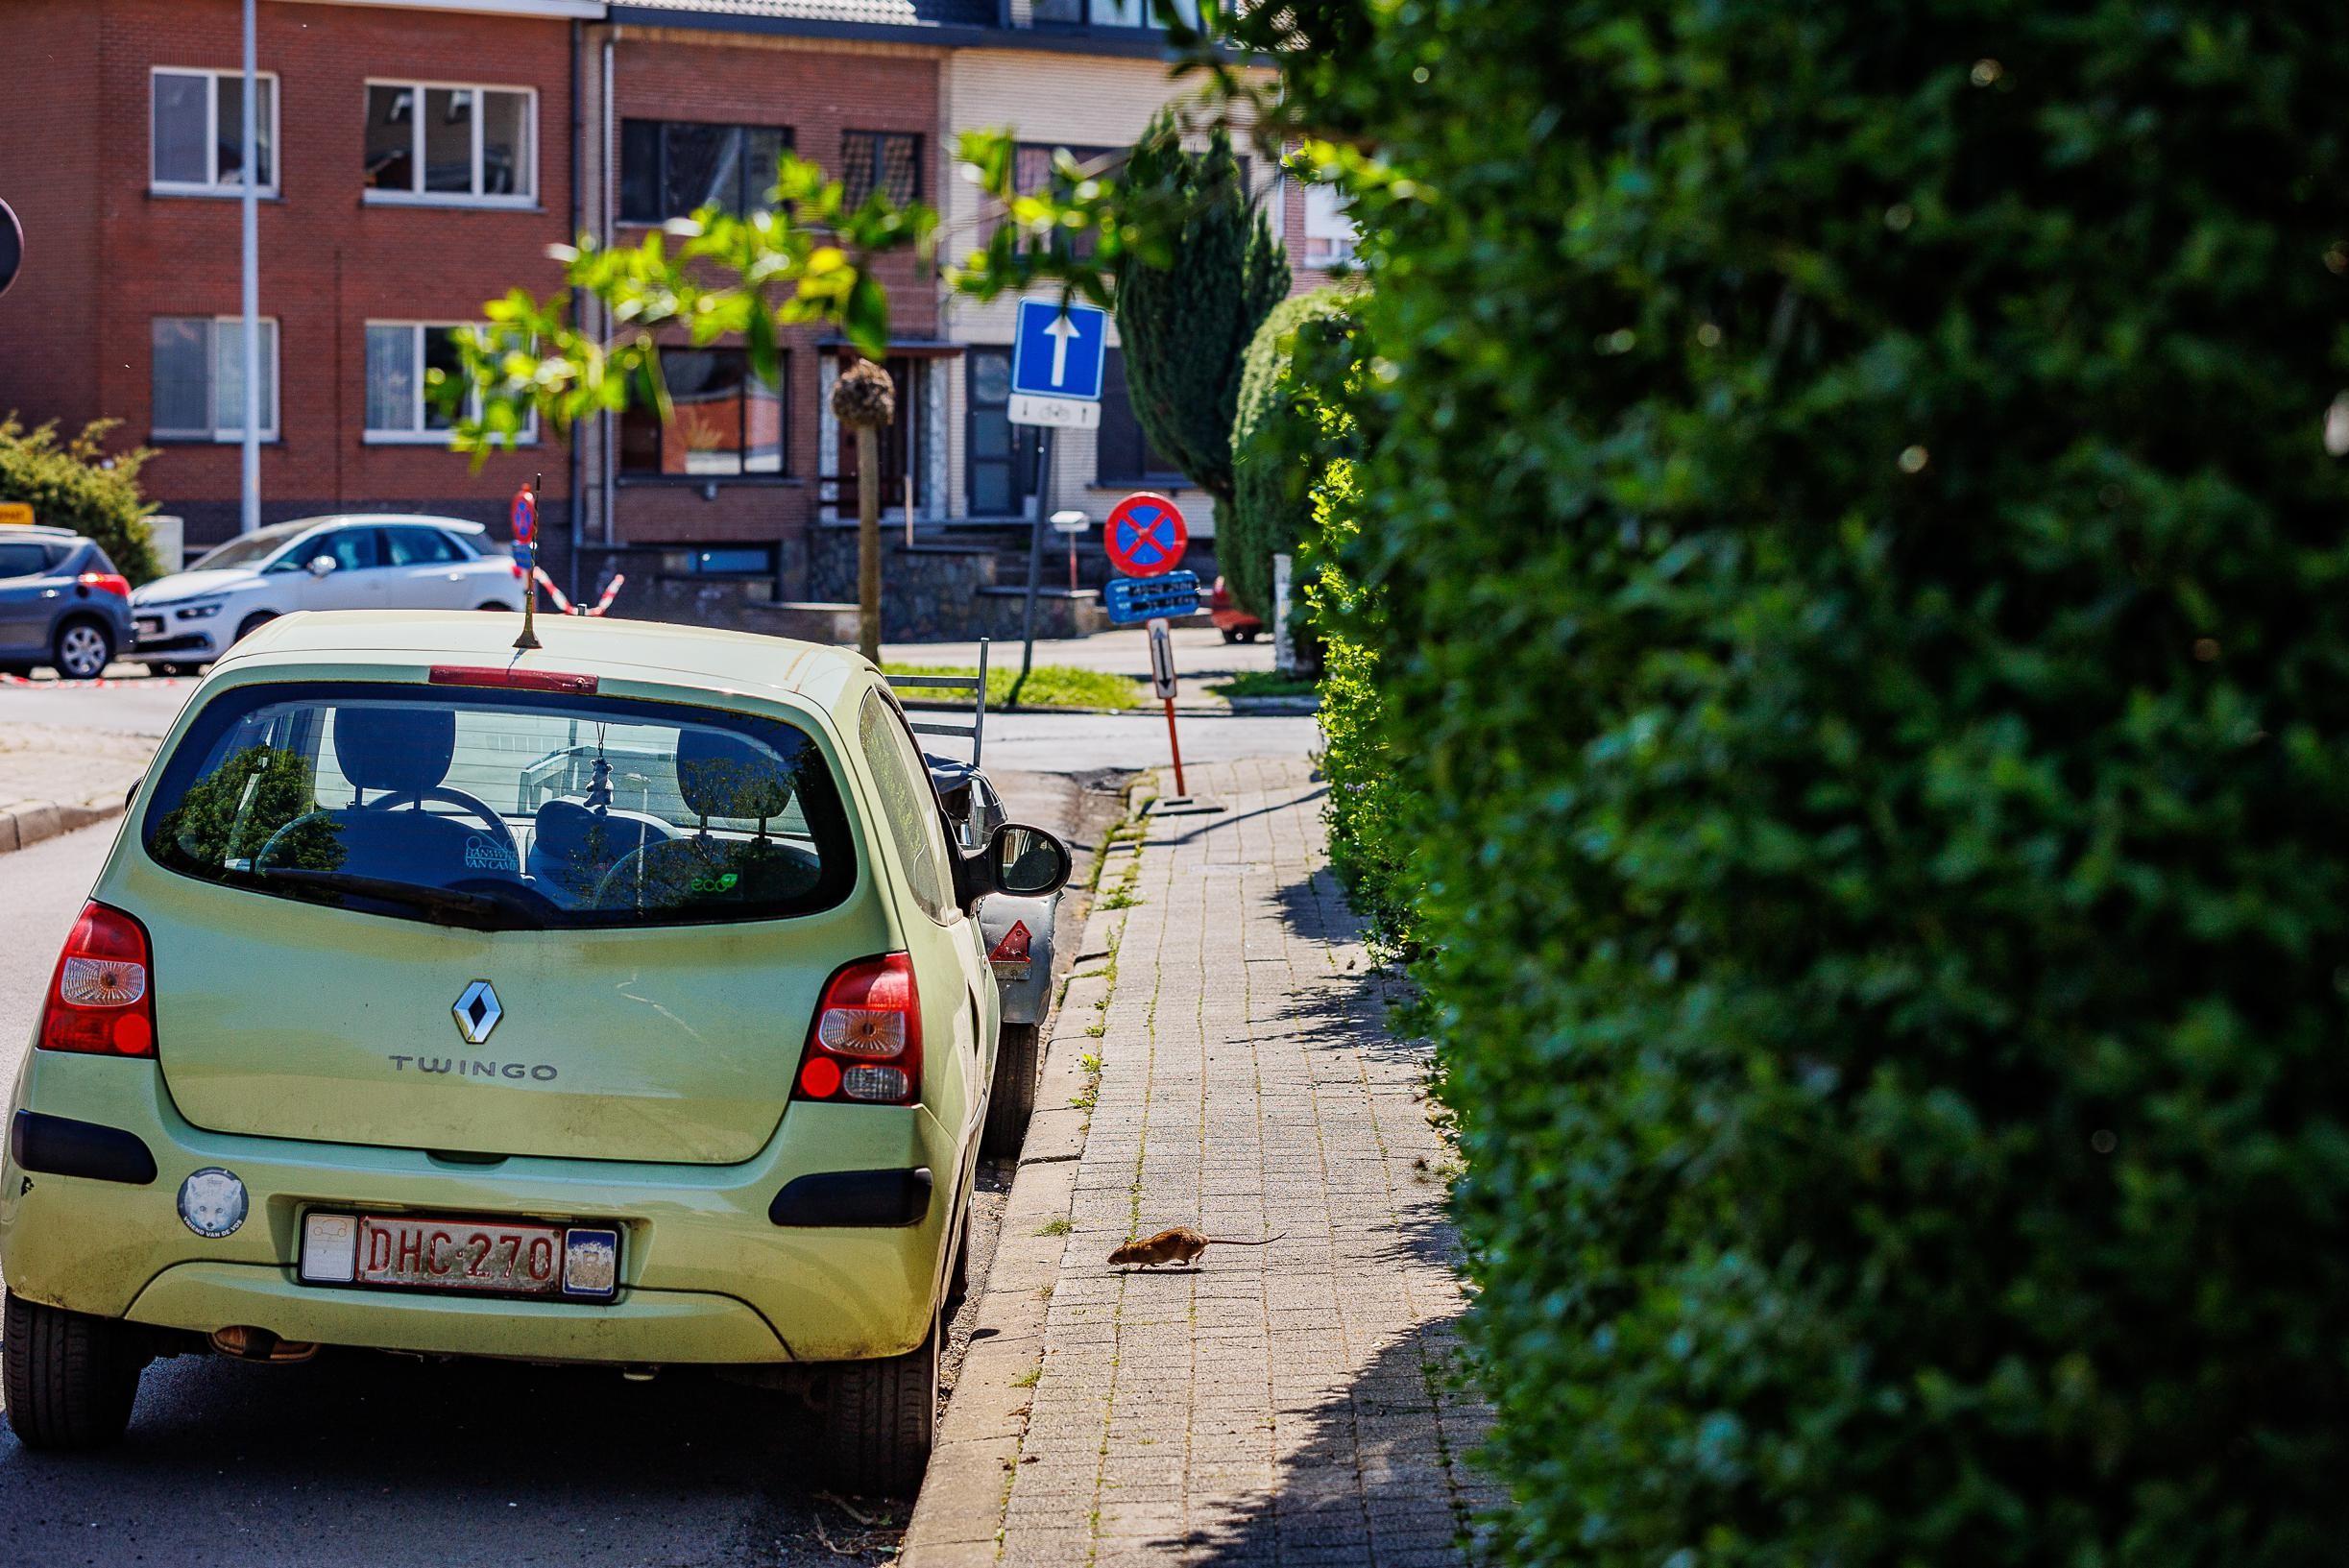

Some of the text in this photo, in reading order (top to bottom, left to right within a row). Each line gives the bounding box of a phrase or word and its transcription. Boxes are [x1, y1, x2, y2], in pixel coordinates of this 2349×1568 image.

[466, 857, 487, 869] VAN
[690, 879, 728, 892] eco
[388, 1055, 558, 1081] TWINGO
